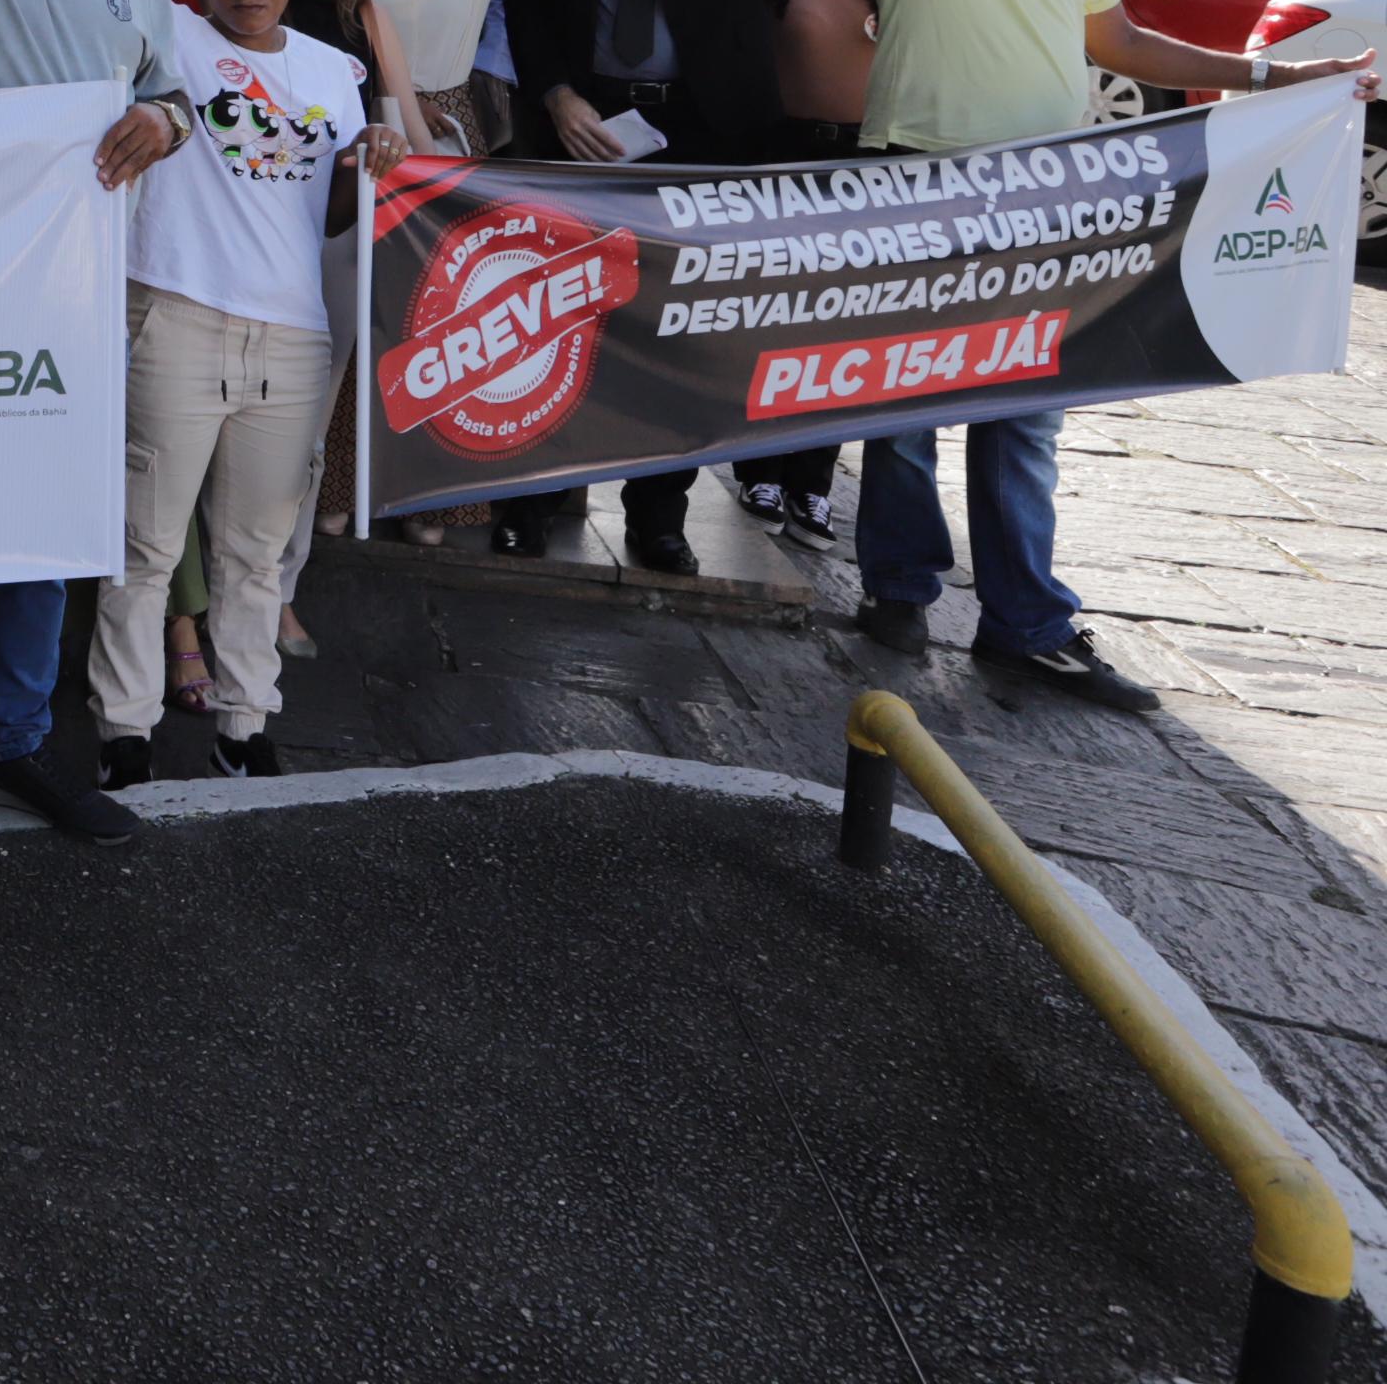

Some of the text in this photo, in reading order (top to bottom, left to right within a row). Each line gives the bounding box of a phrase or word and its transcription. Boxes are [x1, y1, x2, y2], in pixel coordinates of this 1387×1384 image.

[1069, 135, 1169, 184] DOS
[443, 215, 538, 286] ADEP-BA
[670, 180, 1176, 285] DEFENSORES PÚBLICOS É
[1213, 223, 1329, 264] ADEP-BA
[403, 256, 605, 401] GREVE!
[656, 243, 1155, 337] DESVALORIZAÇÃO DO POVO.
[452, 333, 583, 437] Basta de desrespeito
[759, 309, 1061, 407] PLC 154 JÁ!
[28, 408, 41, 417] da
[42, 407, 68, 417] Bahia
